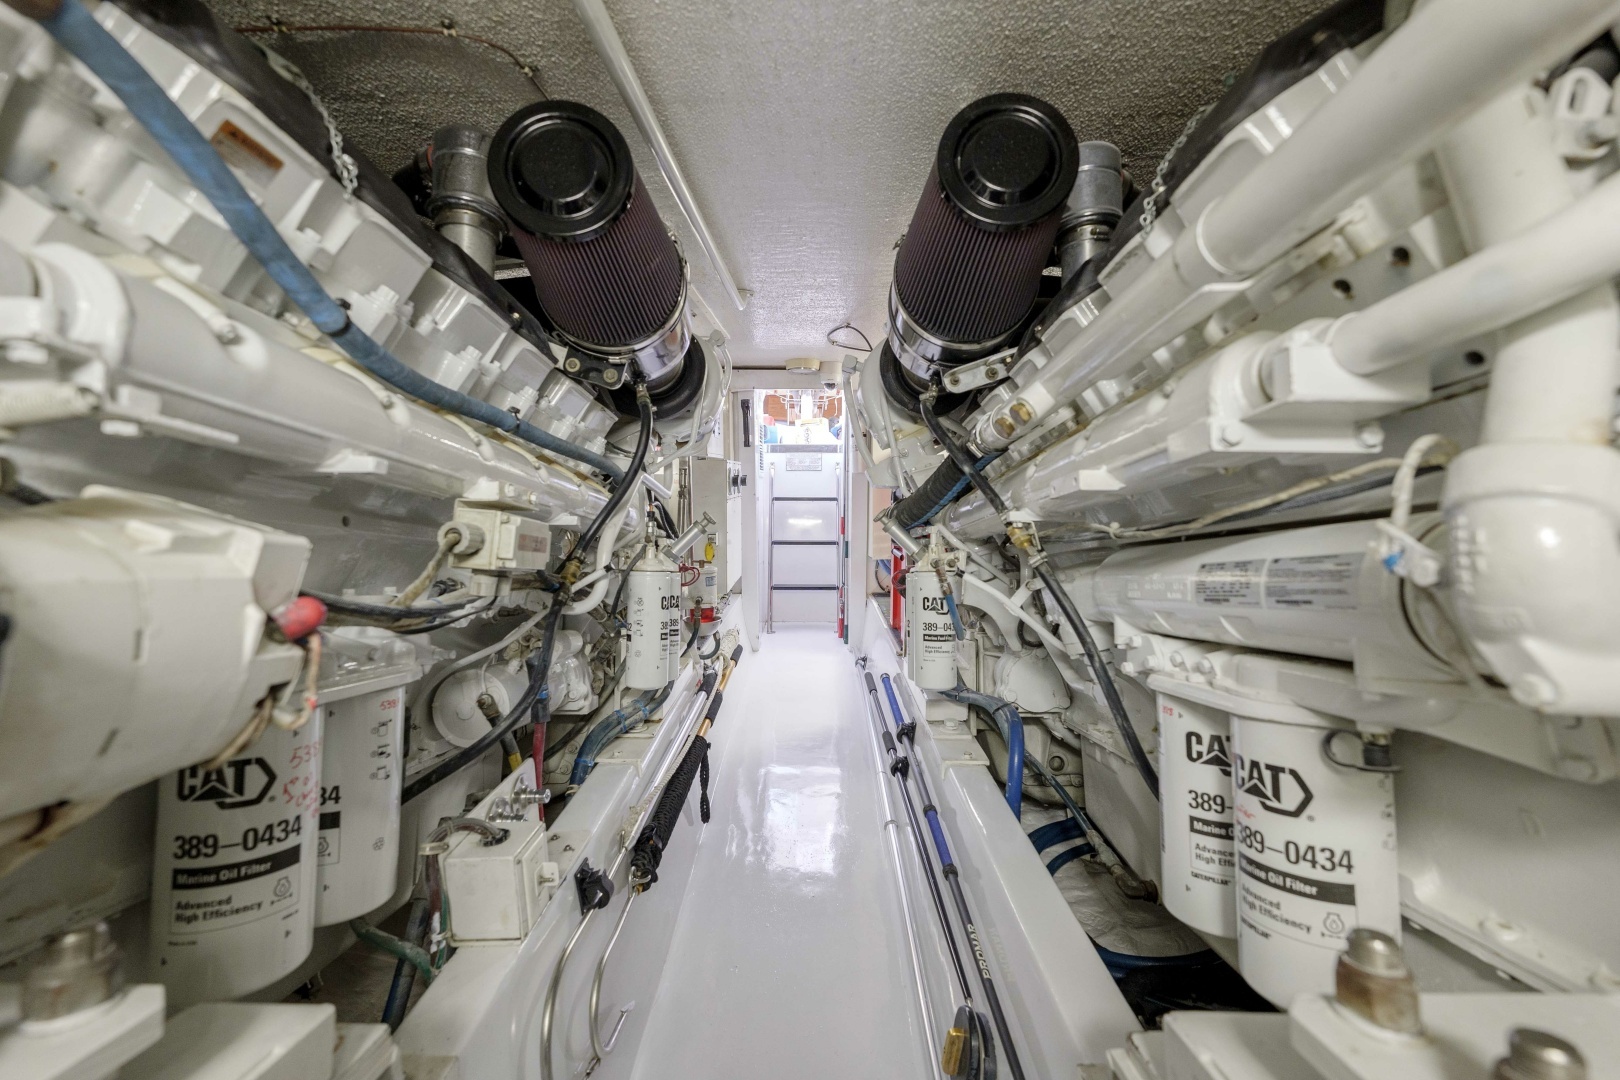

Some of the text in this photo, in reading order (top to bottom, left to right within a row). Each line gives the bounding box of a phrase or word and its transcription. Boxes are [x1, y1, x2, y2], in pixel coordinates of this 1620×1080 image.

[923, 596, 946, 611] CAT
[1186, 731, 1232, 768] CA
[177, 757, 253, 802] CAT
[1234, 753, 1287, 804] CAT
[173, 814, 302, 860] 389-0434
[219, 867, 238, 881] Oil
[239, 861, 273, 877] Filter
[1267, 871, 1284, 887] Oil
[1284, 877, 1319, 896] Filter
[175, 895, 232, 911] Advanced
[202, 901, 263, 920] Efficiency
